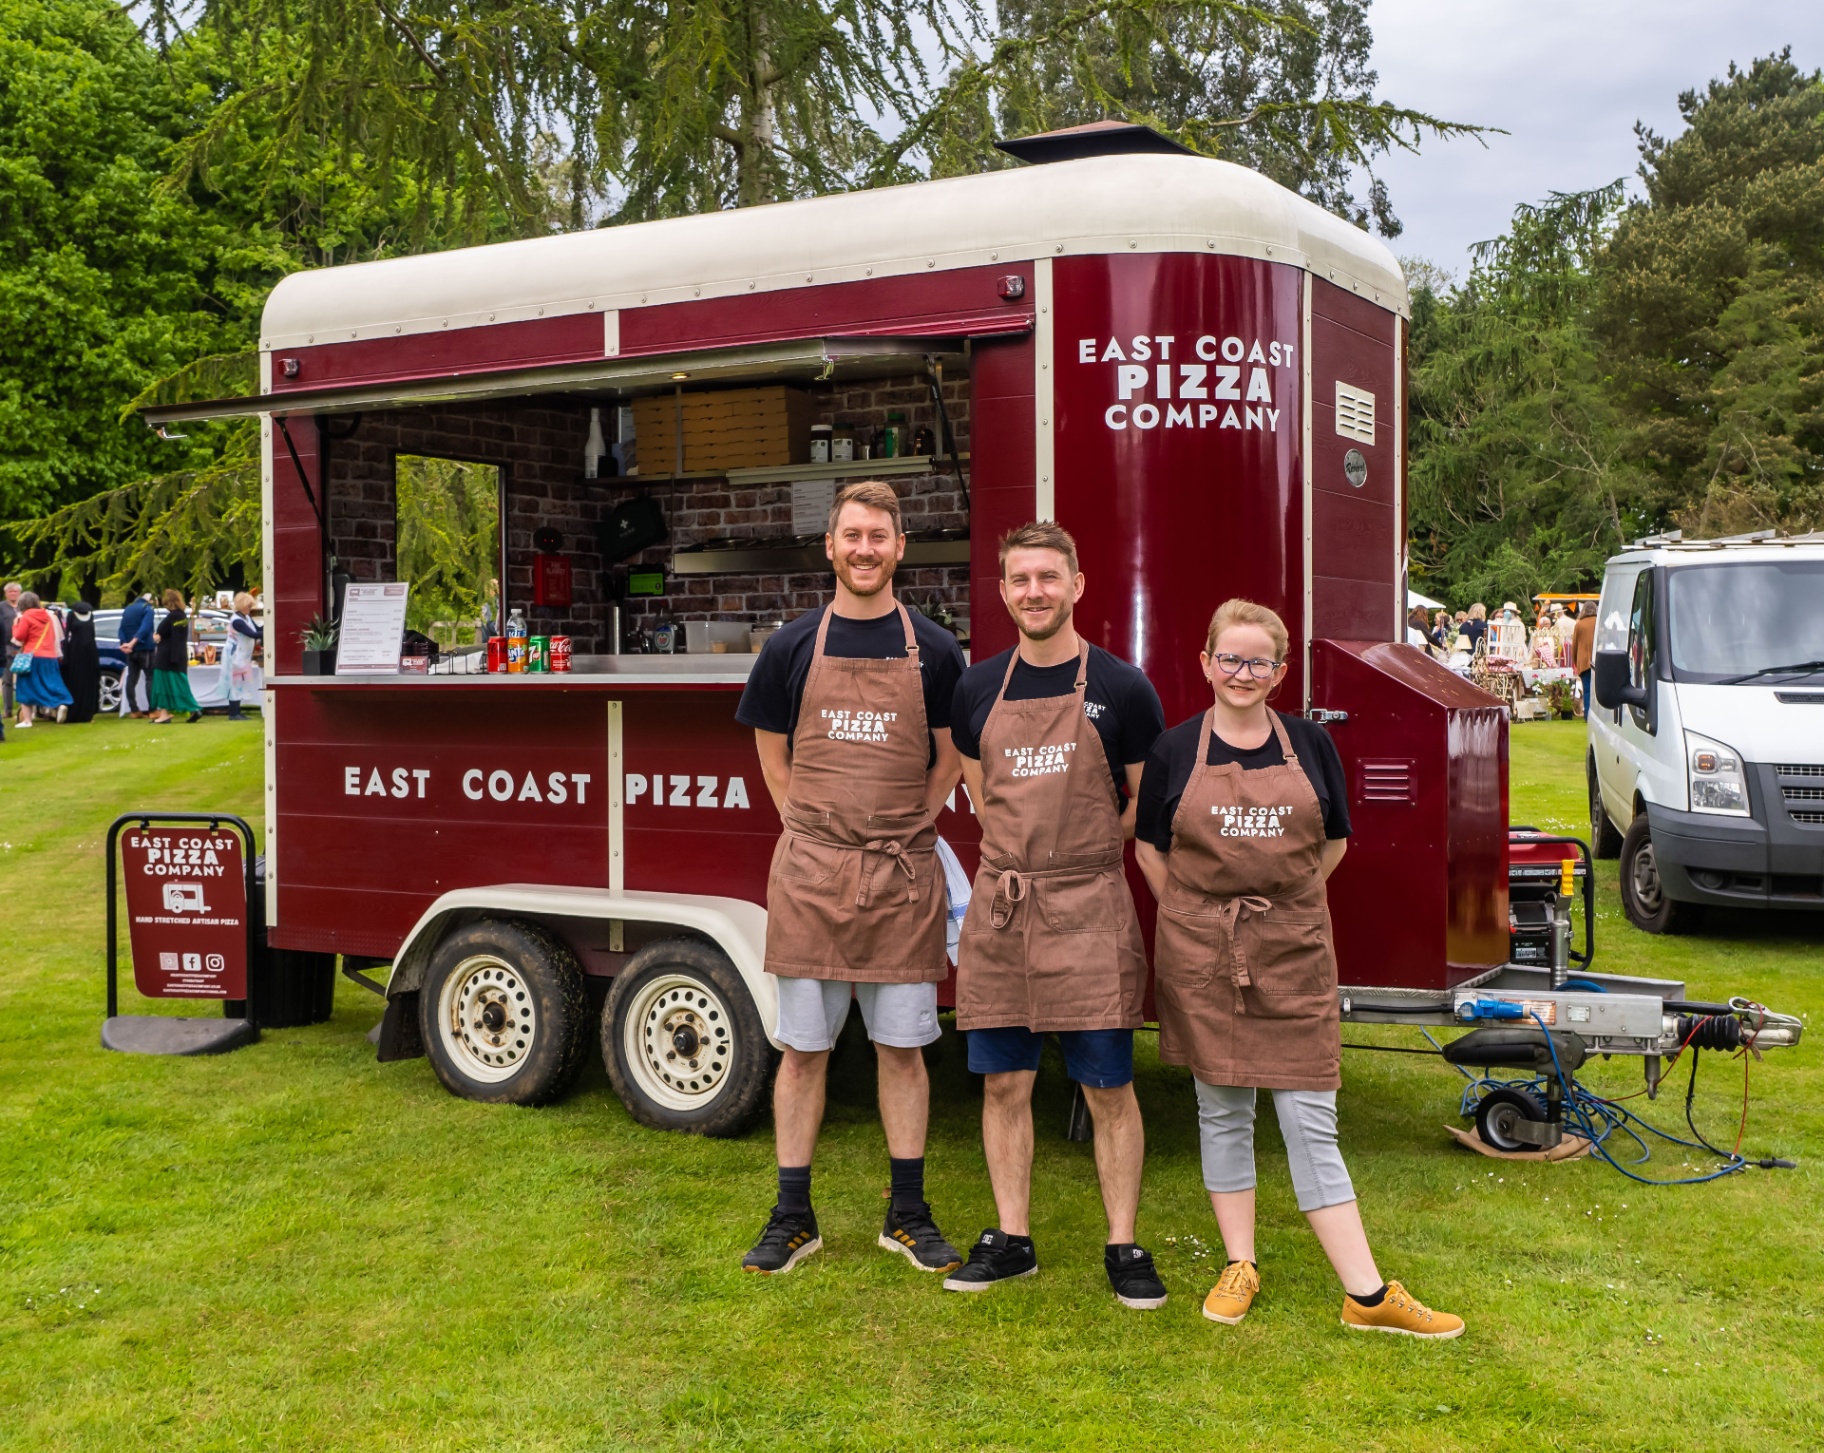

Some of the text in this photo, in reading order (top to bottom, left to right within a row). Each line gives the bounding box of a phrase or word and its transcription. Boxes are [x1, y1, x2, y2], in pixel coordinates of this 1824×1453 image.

[1079, 335, 1294, 368] EAST COAST
[1117, 364, 1272, 403] PIZZA
[1105, 403, 1281, 432] COMPANY
[821, 709, 898, 722] EAST COAST
[831, 719, 885, 733] PIZZA
[827, 730, 889, 742] COMPANY
[1004, 742, 1077, 757] EAST COAST
[1016, 752, 1065, 768] PIZZA
[1011, 763, 1069, 777] COMPANY
[345, 766, 750, 809] EAST COAST PIZZA
[1211, 806, 1293, 816] EAST COAST
[1224, 815, 1280, 828] PIZZA
[1220, 827, 1285, 838] COMPANY
[130, 836, 234, 850] EAST COAST
[147, 848, 219, 865] PIZZA
[143, 863, 225, 877] COMPANY
[220, 918, 239, 926] PIZZA
